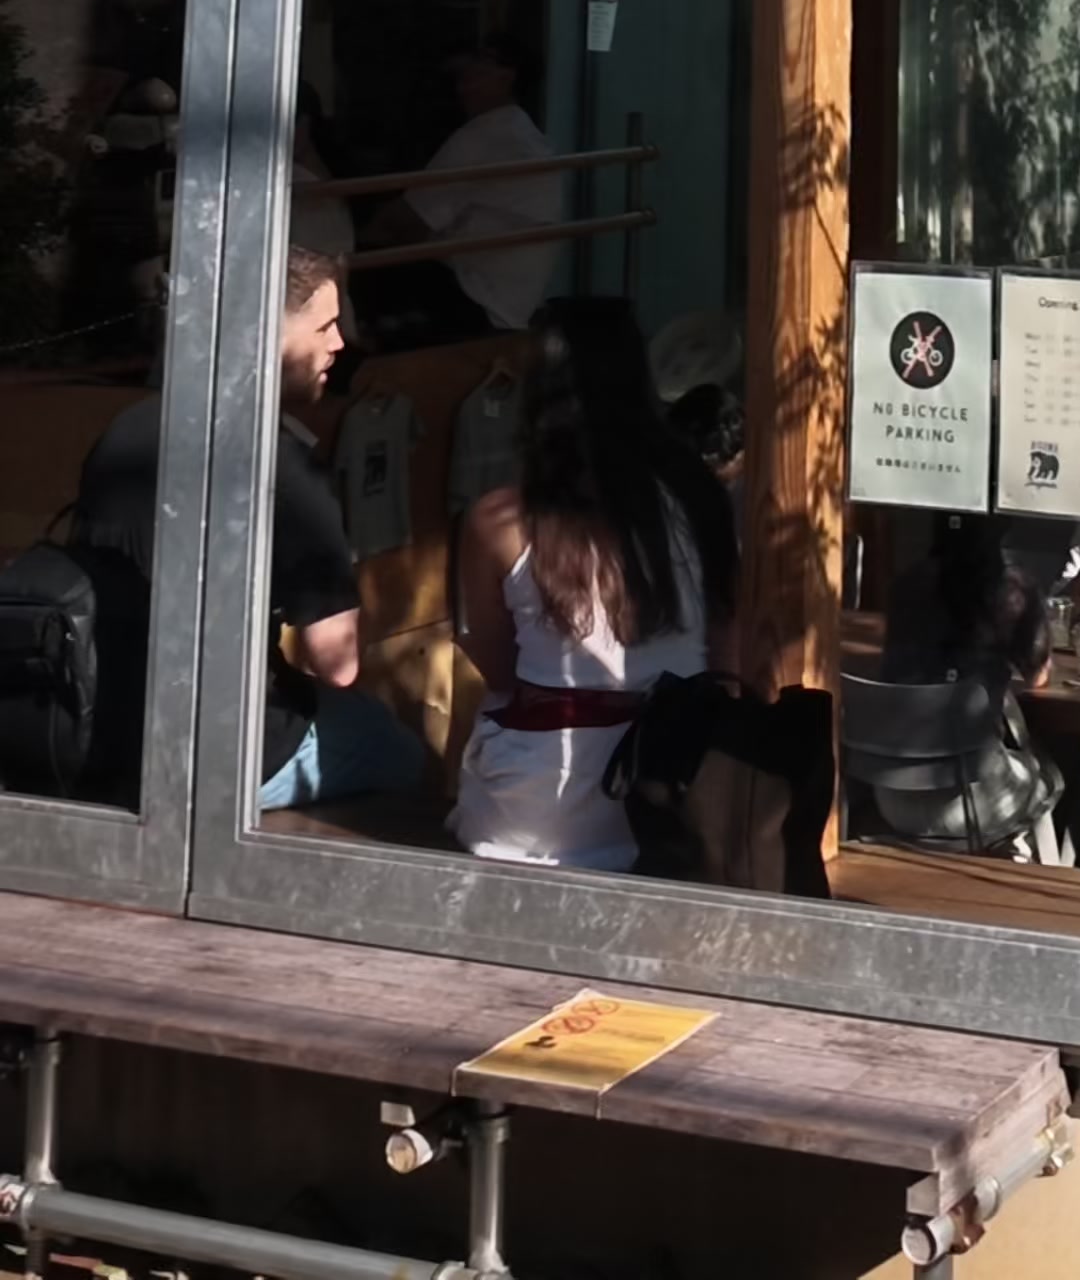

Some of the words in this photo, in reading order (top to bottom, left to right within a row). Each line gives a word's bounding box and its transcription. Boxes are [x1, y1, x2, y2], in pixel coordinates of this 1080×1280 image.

[873, 402, 893, 416] NO
[902, 403, 968, 421] BICYCLE
[885, 425, 954, 443] PARKING
